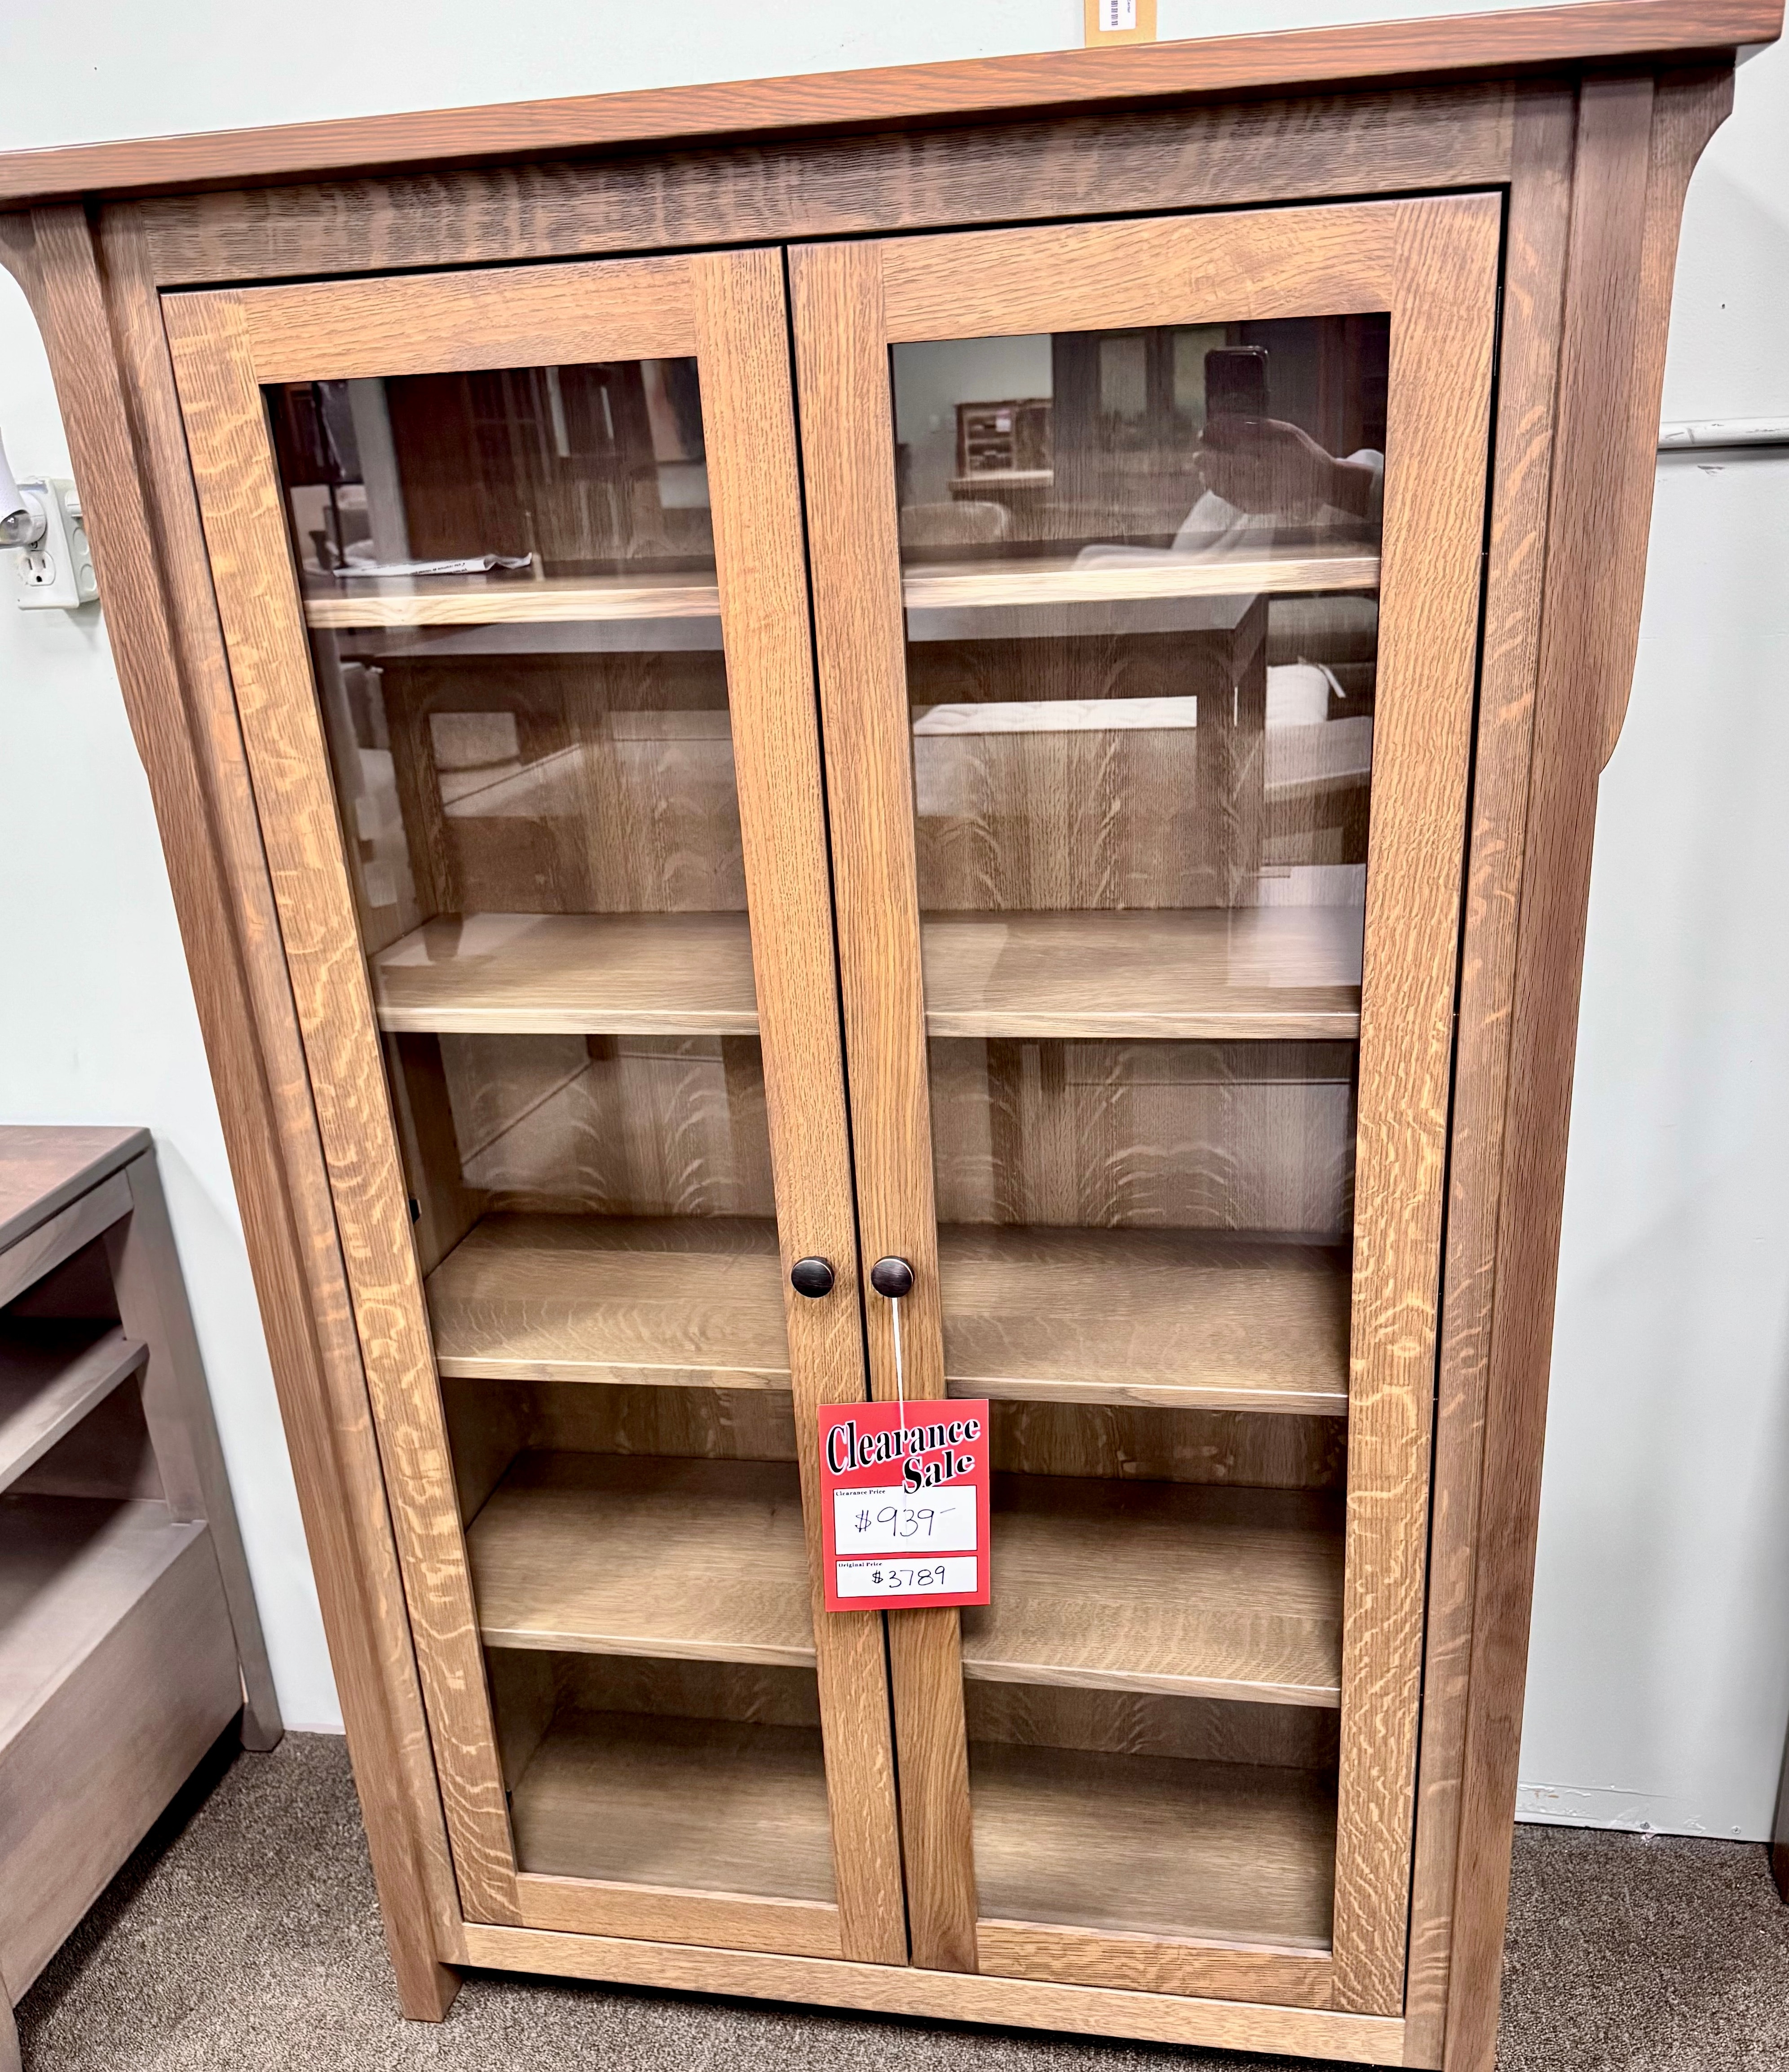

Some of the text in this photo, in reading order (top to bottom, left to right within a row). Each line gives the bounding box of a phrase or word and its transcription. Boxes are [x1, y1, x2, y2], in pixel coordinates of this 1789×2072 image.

[827, 1418, 980, 1474] Clearance
[903, 1450, 975, 1494] Sale
[871, 1565, 945, 1588] $3789
